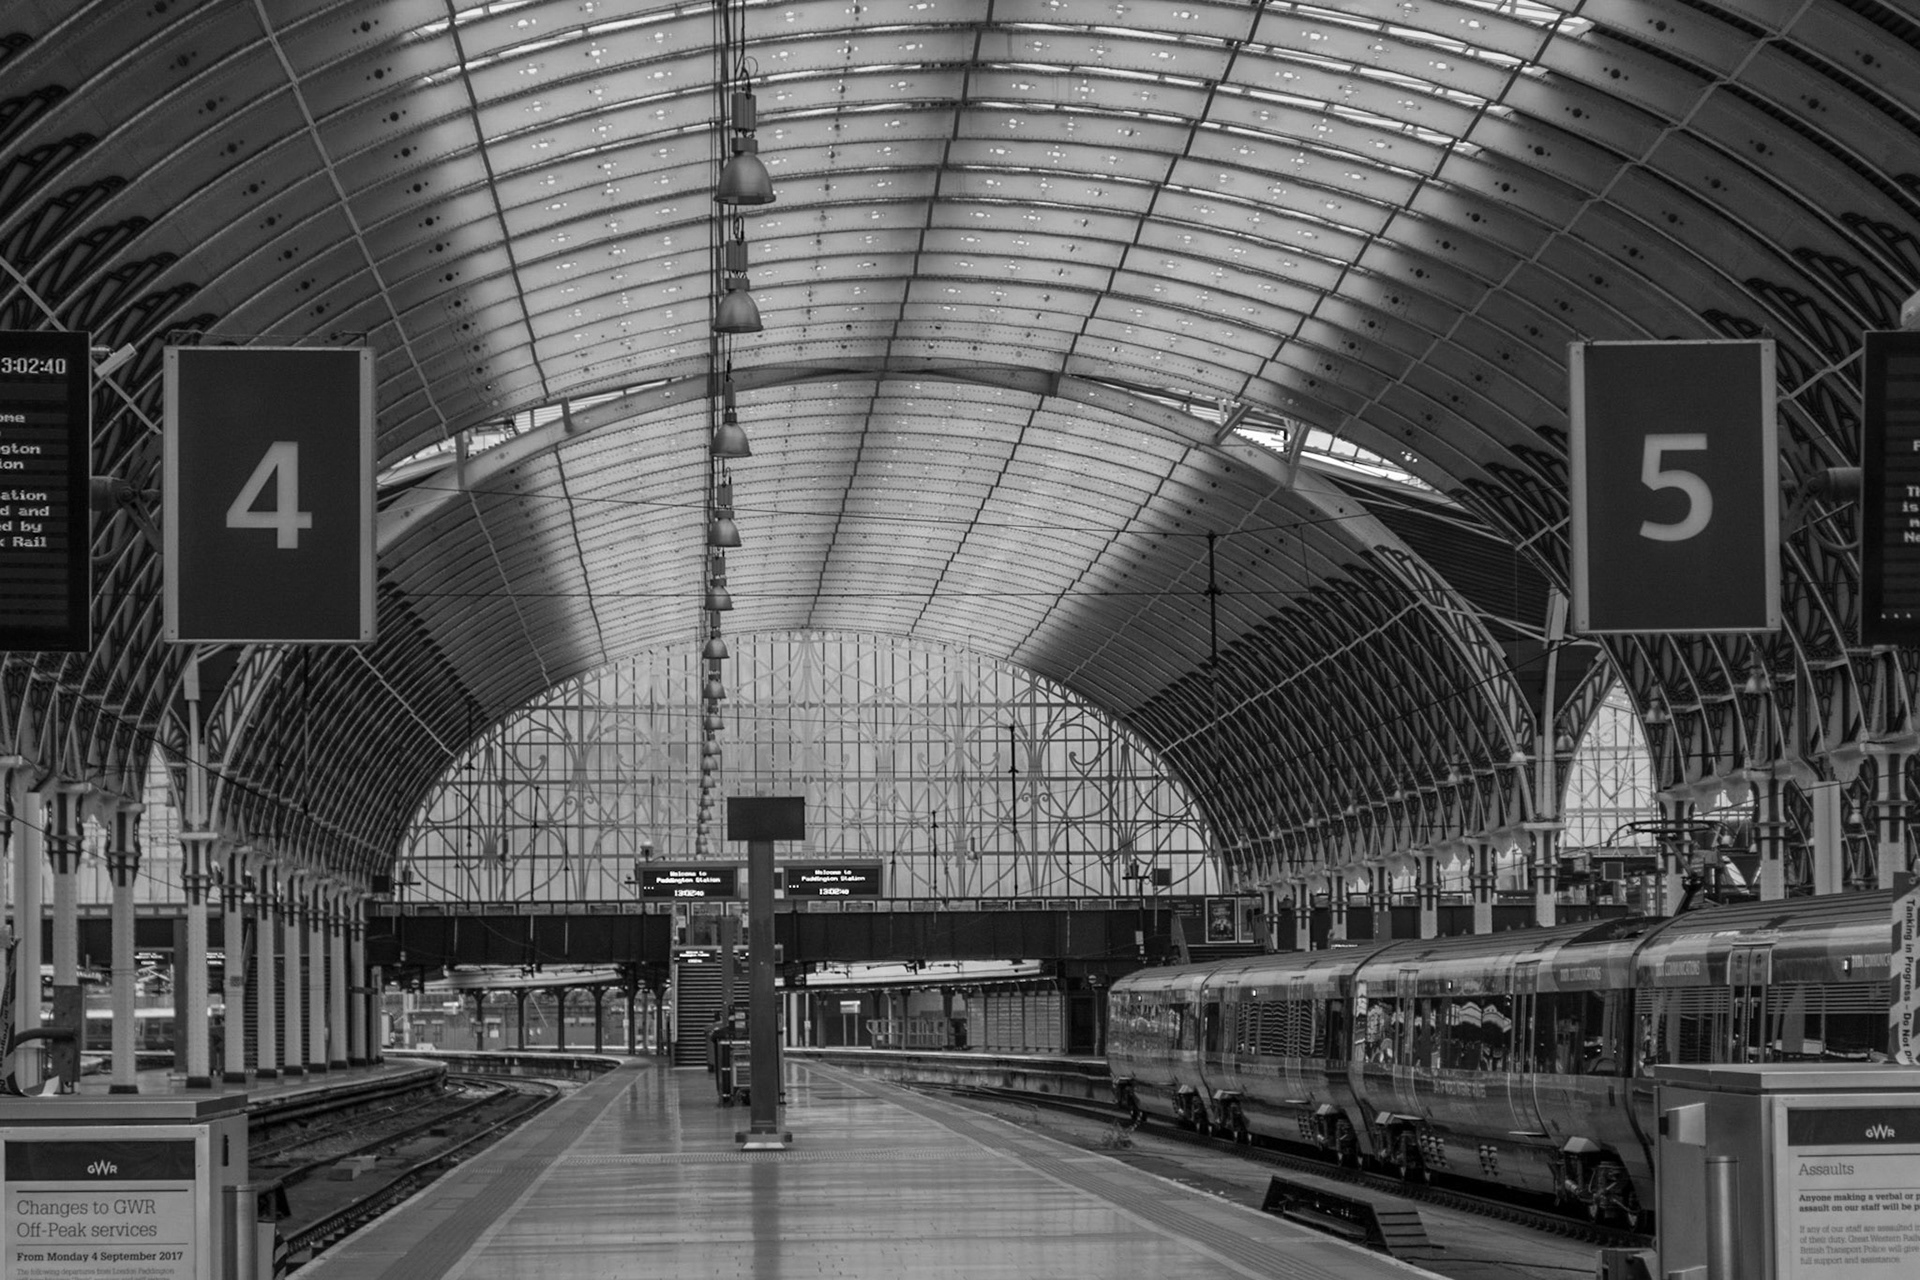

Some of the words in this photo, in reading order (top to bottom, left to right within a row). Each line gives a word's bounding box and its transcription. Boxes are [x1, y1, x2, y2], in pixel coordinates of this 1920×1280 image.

[1640, 433, 1713, 542] 5
[1, 490, 47, 501] ation
[226, 440, 312, 549] 4
[18, 506, 50, 516] and
[1902, 500, 1918, 512] is
[20, 521, 42, 534] by
[12, 536, 47, 548] Rail
[1904, 899, 1915, 941] Tanking
[1905, 943, 1913, 954] in
[1903, 956, 1914, 1001] Progress
[1903, 1013, 1912, 1026] Do
[1903, 1028, 1912, 1048] Not
[1865, 1124, 1895, 1139] GWR
[87, 1160, 118, 1175] GWR
[1798, 1163, 1854, 1176] Assaults
[1799, 1194, 1832, 1203] Anyone
[1834, 1194, 1866, 1202] making
[1876, 1192, 1902, 1200] verbal
[16, 1200, 89, 1218] Changes
[93, 1201, 109, 1214] to
[114, 1199, 156, 1214] GWR
[1799, 1204, 1830, 1212] assault
[16, 1222, 87, 1238] Off-Peak
[91, 1222, 158, 1237] services
[1807, 1226, 1820, 1234] any
[1846, 1224, 1862, 1232] staff
[1878, 1224, 1913, 1232] assaulted
[1870, 1234, 1901, 1242] Western
[1800, 1246, 1824, 1254] British
[1826, 1246, 1862, 1254] Transport
[1904, 1246, 1920, 1254] give
[16, 1252, 44, 1262] From
[47, 1252, 88, 1263] Monday
[92, 1252, 98, 1260] 4
[100, 1252, 156, 1262] September
[160, 1252, 184, 1260] 2017
[1814, 1257, 1842, 1266] support
[1844, 1256, 1858, 1264] and
[16, 1268, 29, 1276] The
[30, 1268, 60, 1277] following
[62, 1268, 96, 1277] departures
[96, 1268, 111, 1276] from
[112, 1268, 137, 1276] London
[138, 1268, 174, 1277] Paddington
